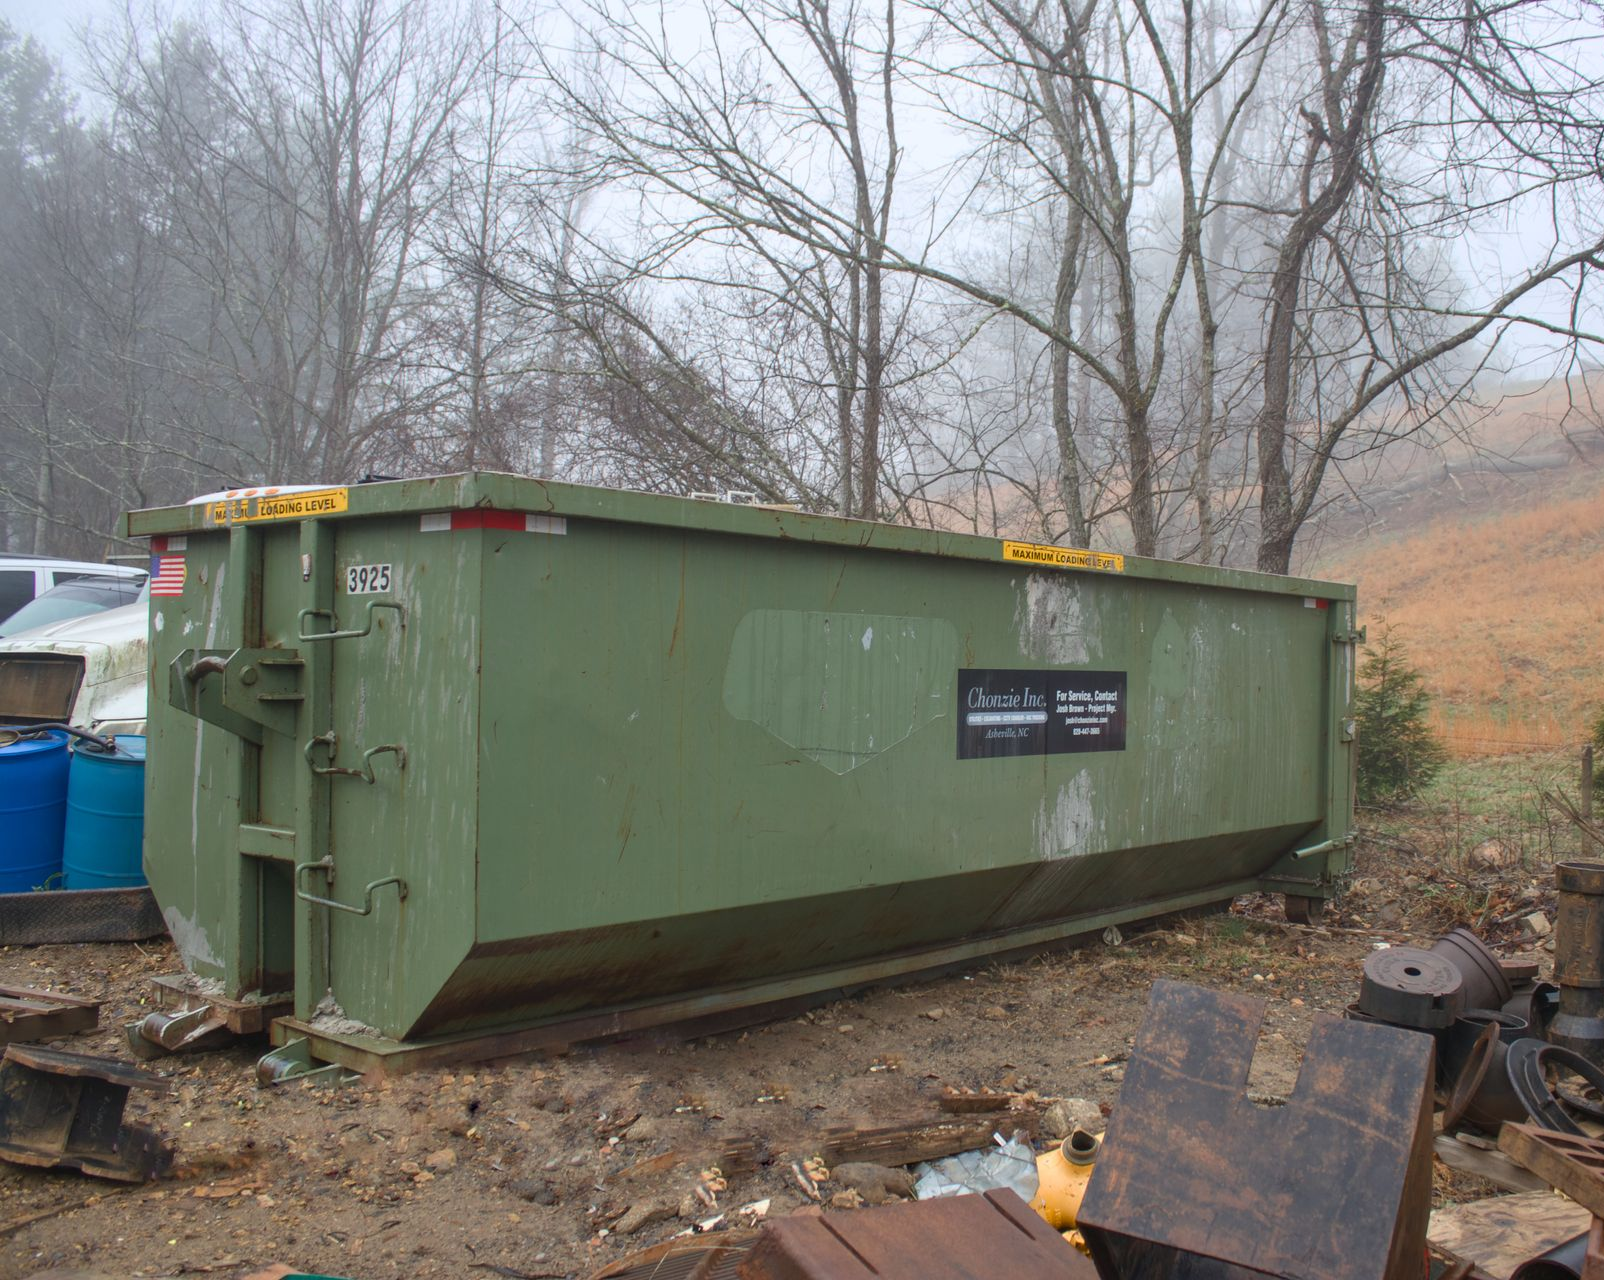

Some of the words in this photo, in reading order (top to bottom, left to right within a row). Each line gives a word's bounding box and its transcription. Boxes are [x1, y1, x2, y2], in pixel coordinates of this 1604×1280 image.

[260, 502, 302, 516] LOADING
[305, 498, 337, 512] LEVEL
[1012, 549, 1054, 562] MAXIMUM
[1092, 557, 1114, 570] LEVE
[349, 566, 390, 592] 3925
[967, 686, 1020, 709] Chonzie
[1022, 687, 1047, 708] Inc.
[1056, 690, 1068, 702] For
[1068, 690, 1094, 703] Service,
[1094, 690, 1118, 702] Contact
[1056, 704, 1069, 714] Josh
[1069, 704, 1084, 713] Brown
[1088, 704, 1105, 715] Project
[1017, 728, 1030, 738] NC
